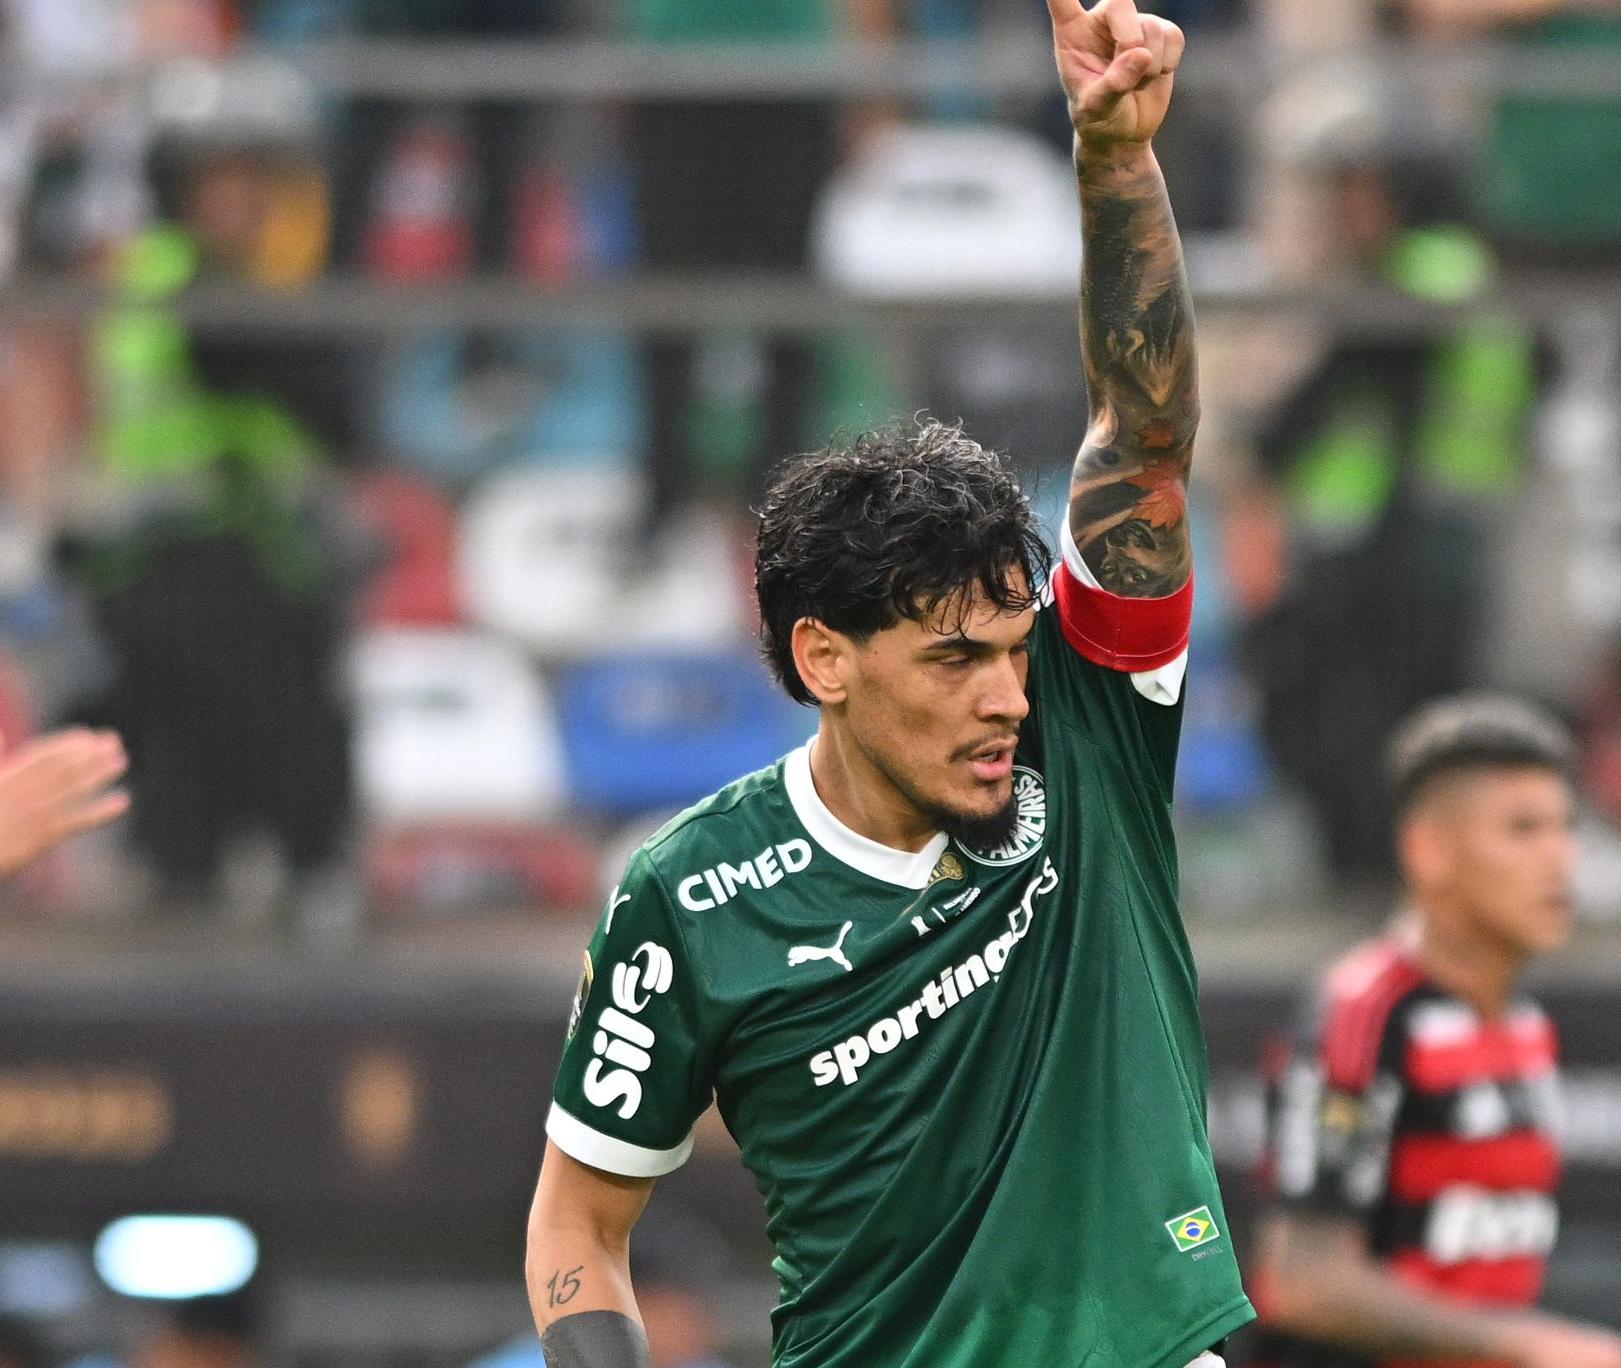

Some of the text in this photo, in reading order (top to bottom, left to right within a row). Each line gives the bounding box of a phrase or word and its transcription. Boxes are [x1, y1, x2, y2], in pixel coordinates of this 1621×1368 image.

[976, 774, 1047, 860] ALMEIRAS
[677, 838, 813, 912] CIMED
[808, 856, 1060, 1087] sporting
[547, 1265, 585, 1309] 15
